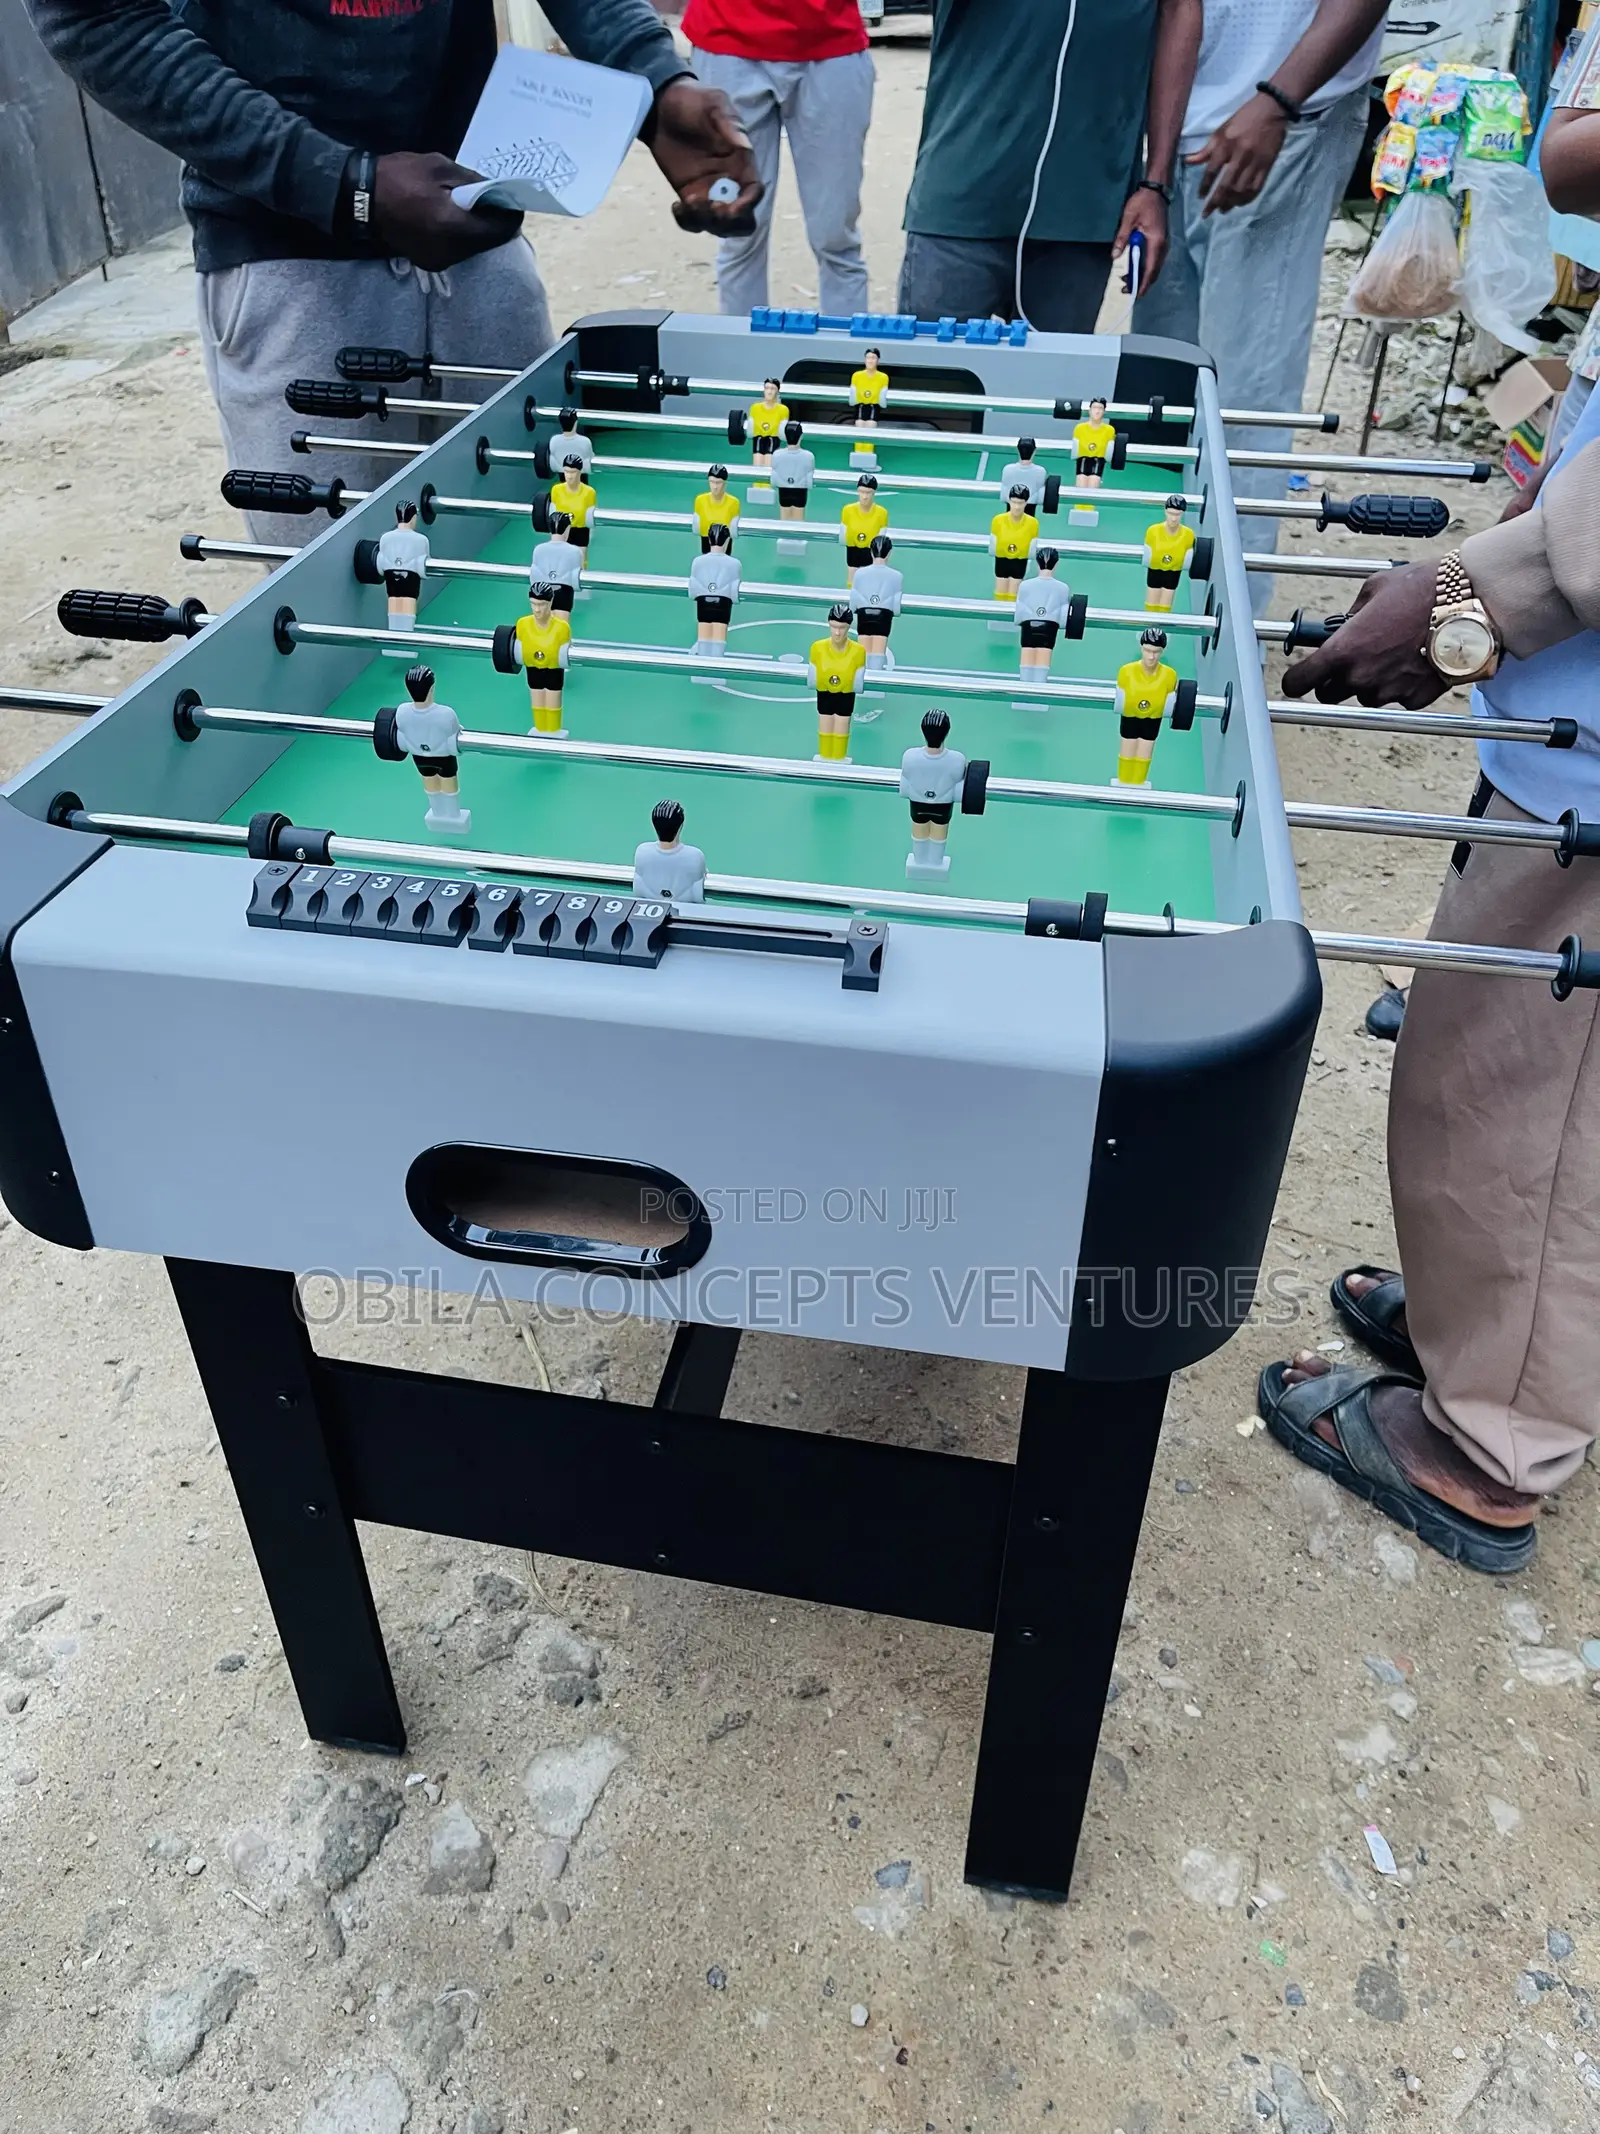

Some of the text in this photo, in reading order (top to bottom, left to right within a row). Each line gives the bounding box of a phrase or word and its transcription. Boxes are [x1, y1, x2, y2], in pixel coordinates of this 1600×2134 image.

[301, 870, 664, 918] 1 2 3 4 5 6 7 8 9 10
